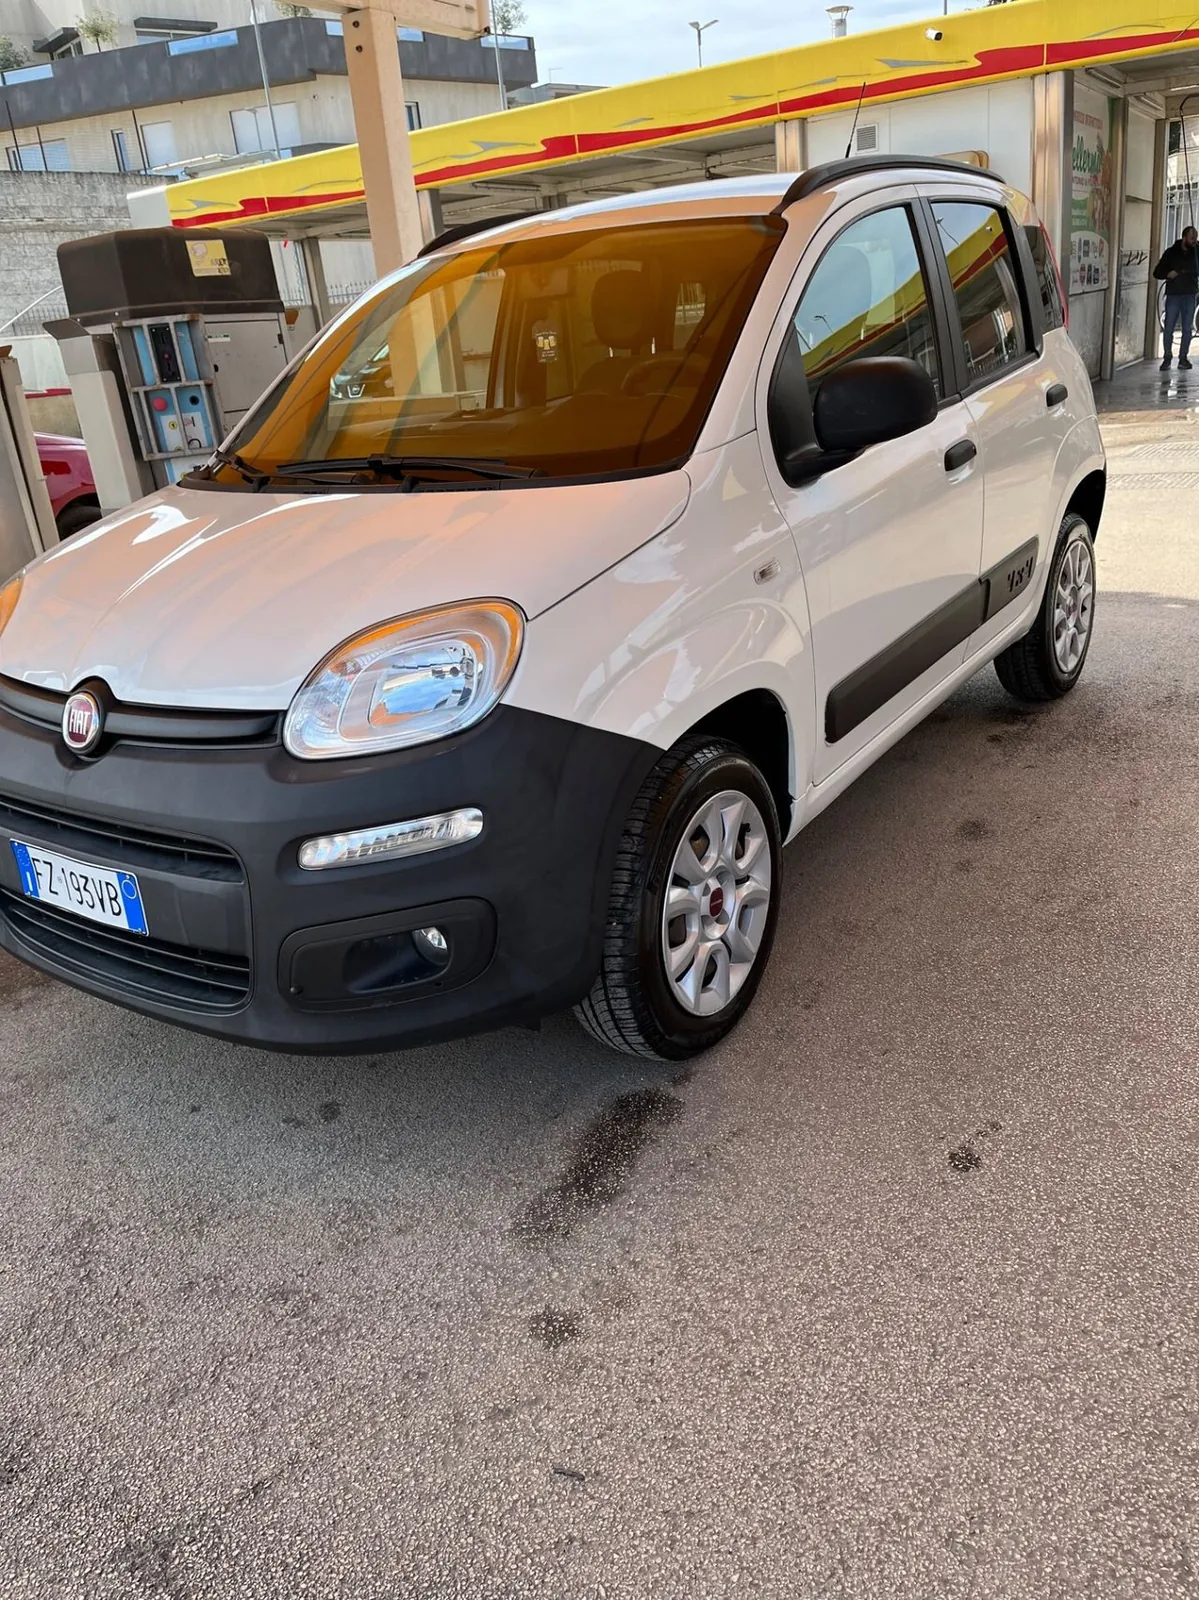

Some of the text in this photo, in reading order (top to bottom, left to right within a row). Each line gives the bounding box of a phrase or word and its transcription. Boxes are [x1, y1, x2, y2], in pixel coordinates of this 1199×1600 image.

[1007, 556, 1034, 593] 4x4
[69, 709, 91, 736] FIAT
[61, 867, 122, 917] 193VB
